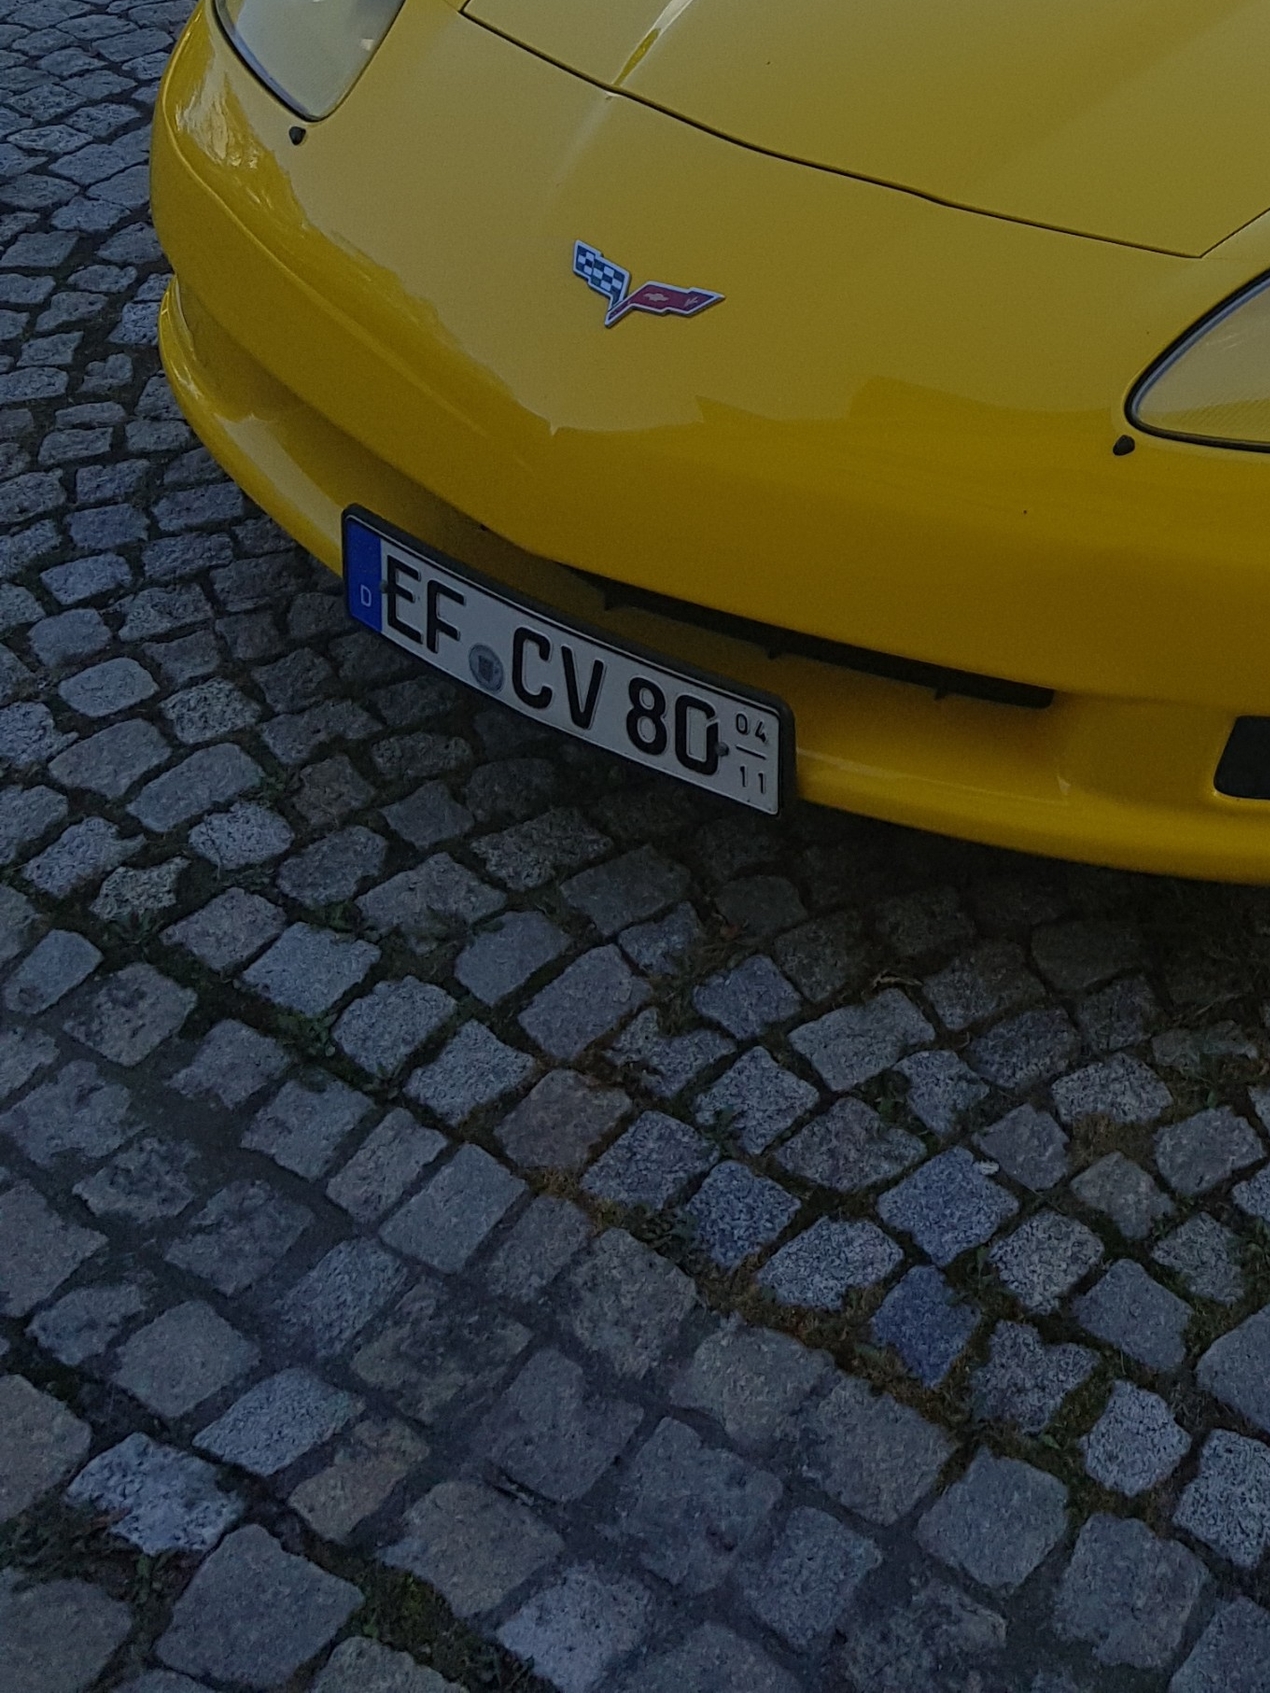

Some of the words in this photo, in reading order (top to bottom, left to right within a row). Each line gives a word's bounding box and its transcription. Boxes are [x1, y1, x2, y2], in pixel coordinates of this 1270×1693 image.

[360, 584, 372, 607] D
[386, 553, 466, 655] EF
[511, 626, 605, 731] CV
[625, 676, 720, 777] 80
[735, 712, 767, 744] 04
[739, 765, 767, 794] 11
